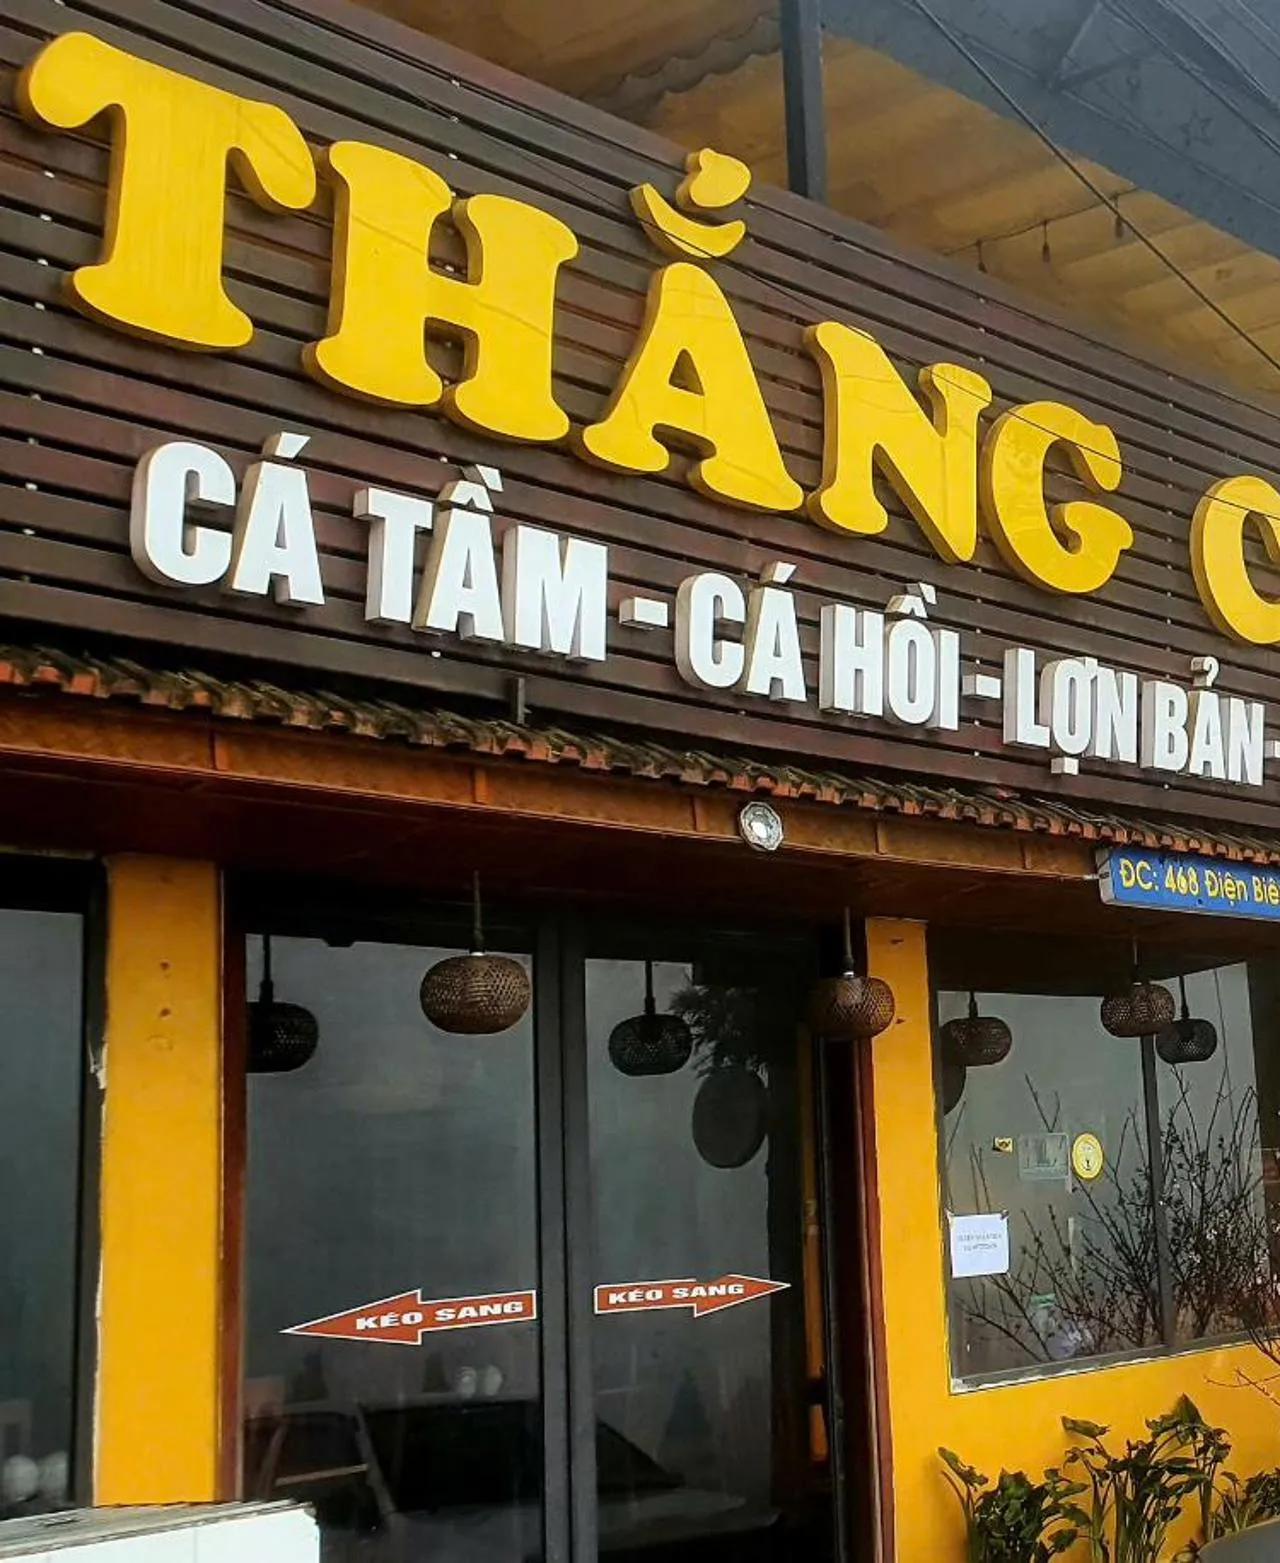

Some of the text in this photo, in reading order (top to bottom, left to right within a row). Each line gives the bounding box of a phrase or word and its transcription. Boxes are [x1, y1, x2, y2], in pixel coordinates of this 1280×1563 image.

[130, 432, 326, 606] CÁ
[352, 464, 609, 662] TẦM
[675, 562, 808, 703] CÁ
[819, 582, 960, 731] HỒI
[1002, 647, 1140, 775] LỢN
[1140, 655, 1266, 786] BẢN
[1119, 858, 1159, 892] ĐC:
[1164, 865, 1199, 896] 468
[1204, 869, 1248, 907] Điện
[607, 1283, 745, 1305] KÉO SANG
[355, 1301, 524, 1332] KÉO SANG
